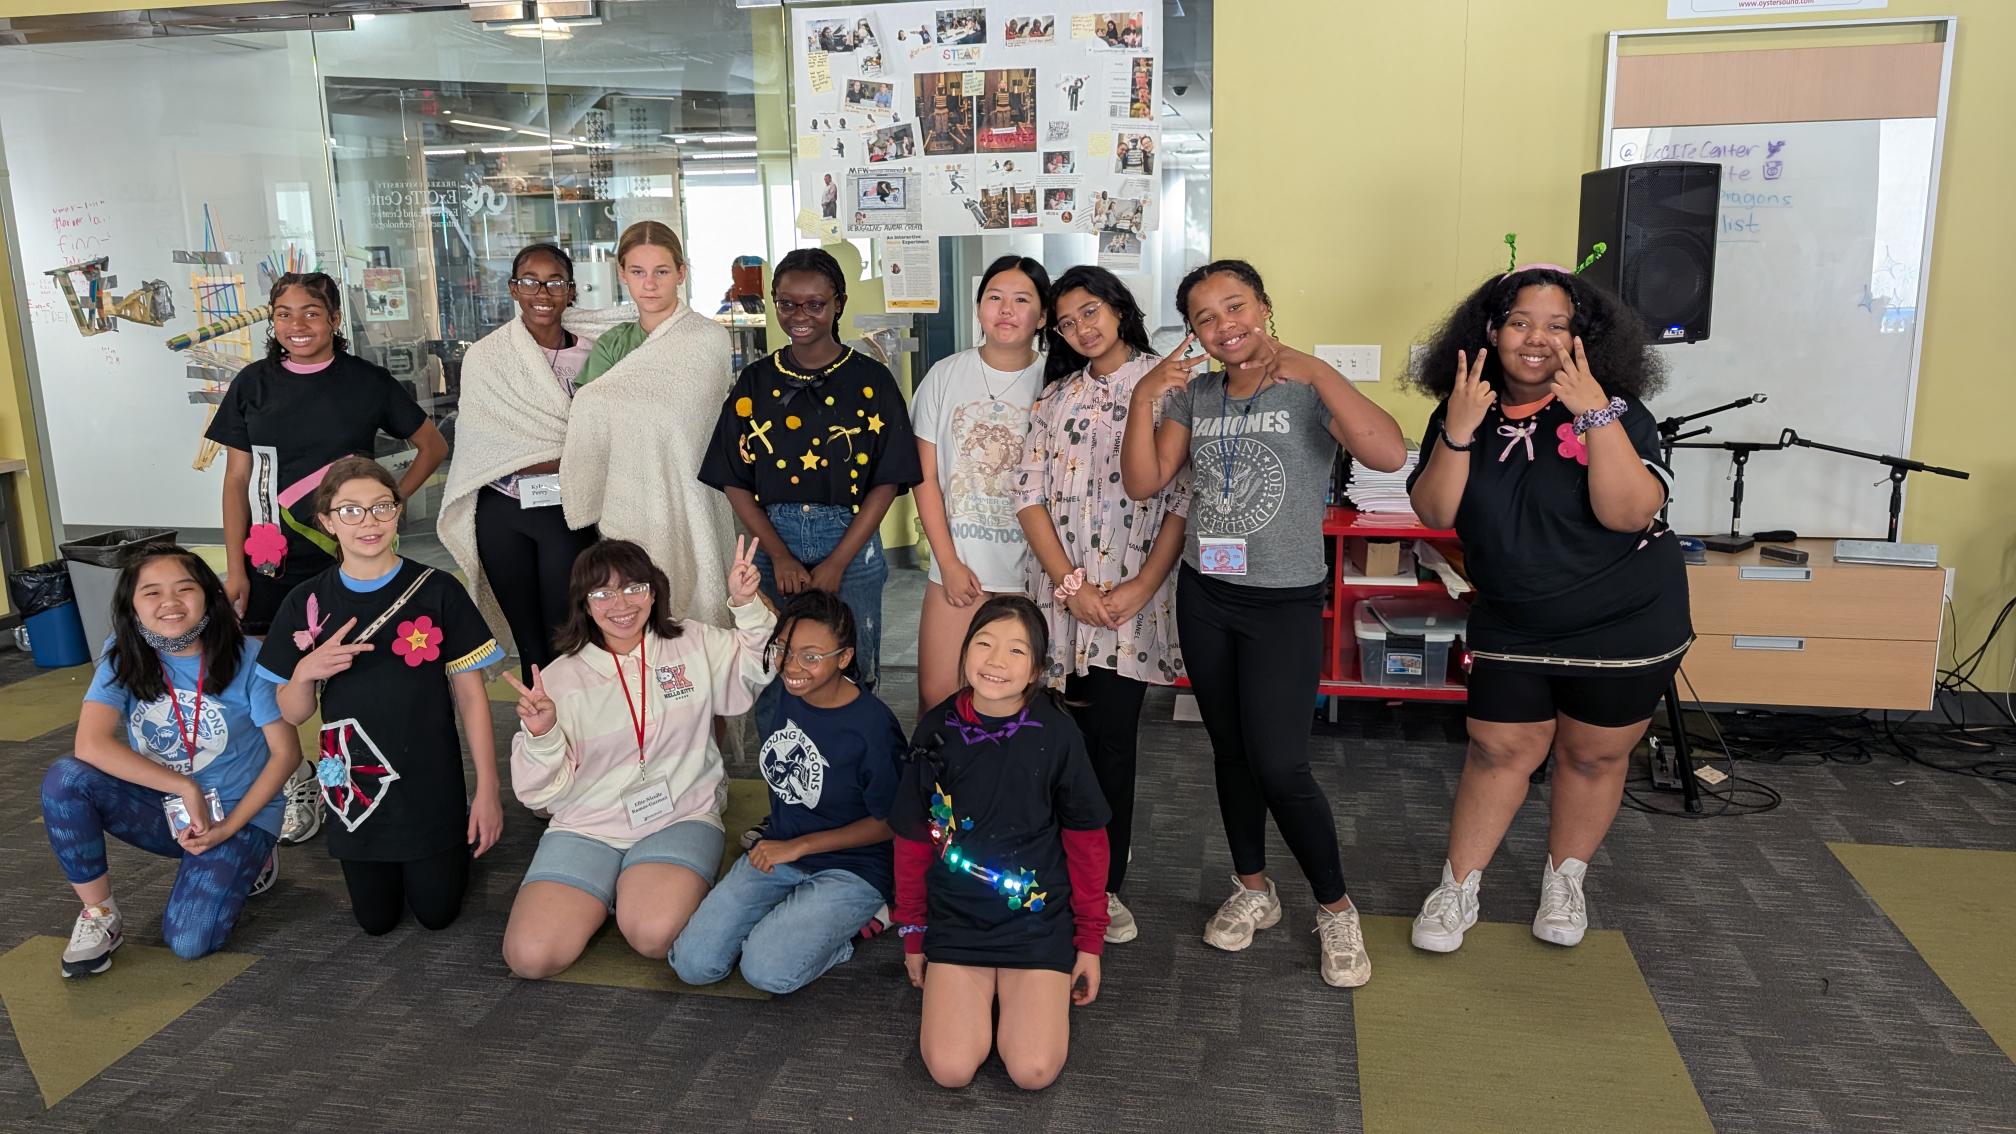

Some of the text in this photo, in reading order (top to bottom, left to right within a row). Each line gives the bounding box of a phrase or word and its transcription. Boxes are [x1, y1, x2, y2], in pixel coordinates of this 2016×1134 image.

[942, 47, 980, 60] STEAM
[1722, 166, 1753, 183] ite
[1192, 411, 1291, 438] RAMONES
[1111, 430, 1123, 458] CHANEL
[1266, 463, 1283, 502] JOEY
[1133, 613, 1144, 639] CHANEL
[664, 691, 681, 699] HELLO
[681, 687, 695, 695] KITTY
[178, 692, 225, 736] RAGONS
[762, 730, 797, 755] YOUNG
